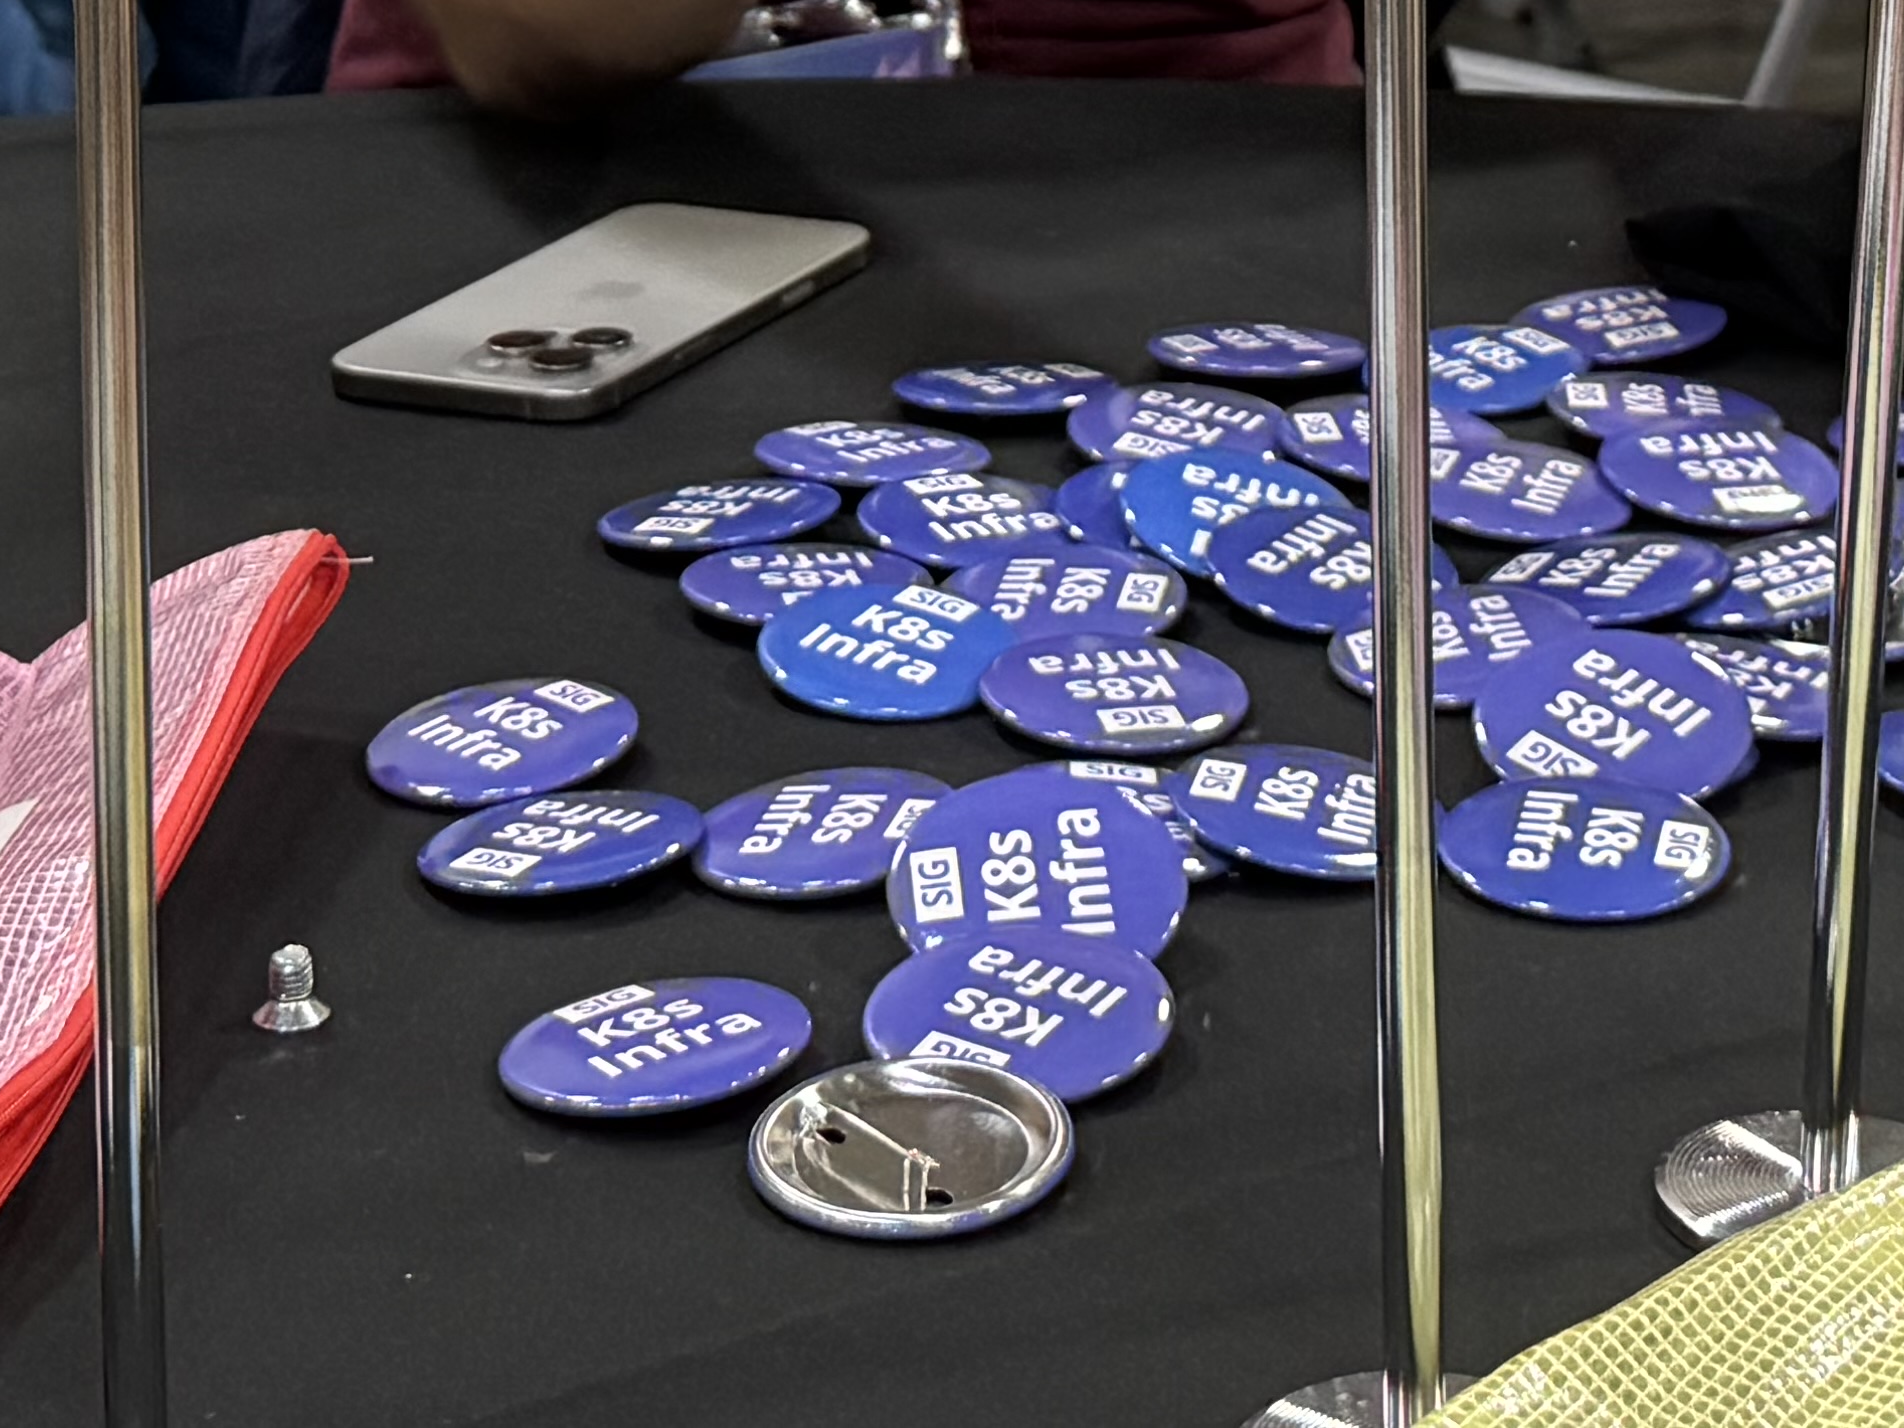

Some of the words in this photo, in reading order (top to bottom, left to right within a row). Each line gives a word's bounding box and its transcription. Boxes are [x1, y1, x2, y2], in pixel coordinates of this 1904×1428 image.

[1130, 409, 1225, 445] K8s
[1139, 389, 1267, 431] Infra
[816, 428, 905, 447] K8s
[836, 436, 957, 463] Infra
[1639, 430, 1778, 456] Infra
[922, 474, 969, 489] SIG
[1458, 452, 1524, 494] K8s
[1511, 457, 1584, 515] Infra
[1678, 456, 1782, 481] K8s
[657, 499, 754, 517] K8s
[675, 484, 802, 504] Infra
[921, 492, 1024, 518] K8s
[928, 510, 1061, 542] Infra
[1246, 513, 1359, 573] Infra
[729, 551, 873, 569] Infra
[759, 569, 863, 588] K8s
[1539, 546, 1617, 586] K8s
[1583, 542, 1681, 599] Infra
[1731, 554, 1835, 591] K8s
[911, 587, 966, 614] SIG
[991, 558, 1055, 622] Infra
[1050, 566, 1112, 615] K8s
[1127, 578, 1161, 607] SIG
[851, 605, 955, 652] K8s
[1467, 594, 1534, 663] Infra
[798, 622, 938, 685] Infra
[1027, 647, 1182, 675] Infra
[549, 682, 597, 706] SIG
[1064, 674, 1176, 701] K8s
[1571, 649, 1713, 739] Infra
[473, 696, 563, 740] K8s
[1112, 709, 1171, 727] SIG
[1544, 690, 1653, 761] K8s
[407, 714, 522, 771] Infra
[1526, 739, 1582, 776] SIG
[1086, 764, 1143, 779] SIG
[1201, 764, 1236, 795] SIG
[1253, 764, 1320, 820] K8s
[523, 798, 660, 834] Infra
[739, 784, 831, 854] Infra
[811, 793, 888, 844] K8s
[1317, 771, 1376, 845] Infra
[492, 821, 596, 853] K8s
[1506, 789, 1580, 871] Infra
[1579, 806, 1644, 869] K8s
[473, 852, 525, 871] SIG
[980, 829, 1042, 922] K8s
[1049, 807, 1116, 935] Infra
[919, 858, 954, 909] SIG
[576, 987, 637, 1015] SIG
[967, 944, 1129, 1017] Infra
[577, 996, 705, 1049] K8s
[942, 986, 1065, 1048] K8s
[587, 1010, 764, 1078] Infra
